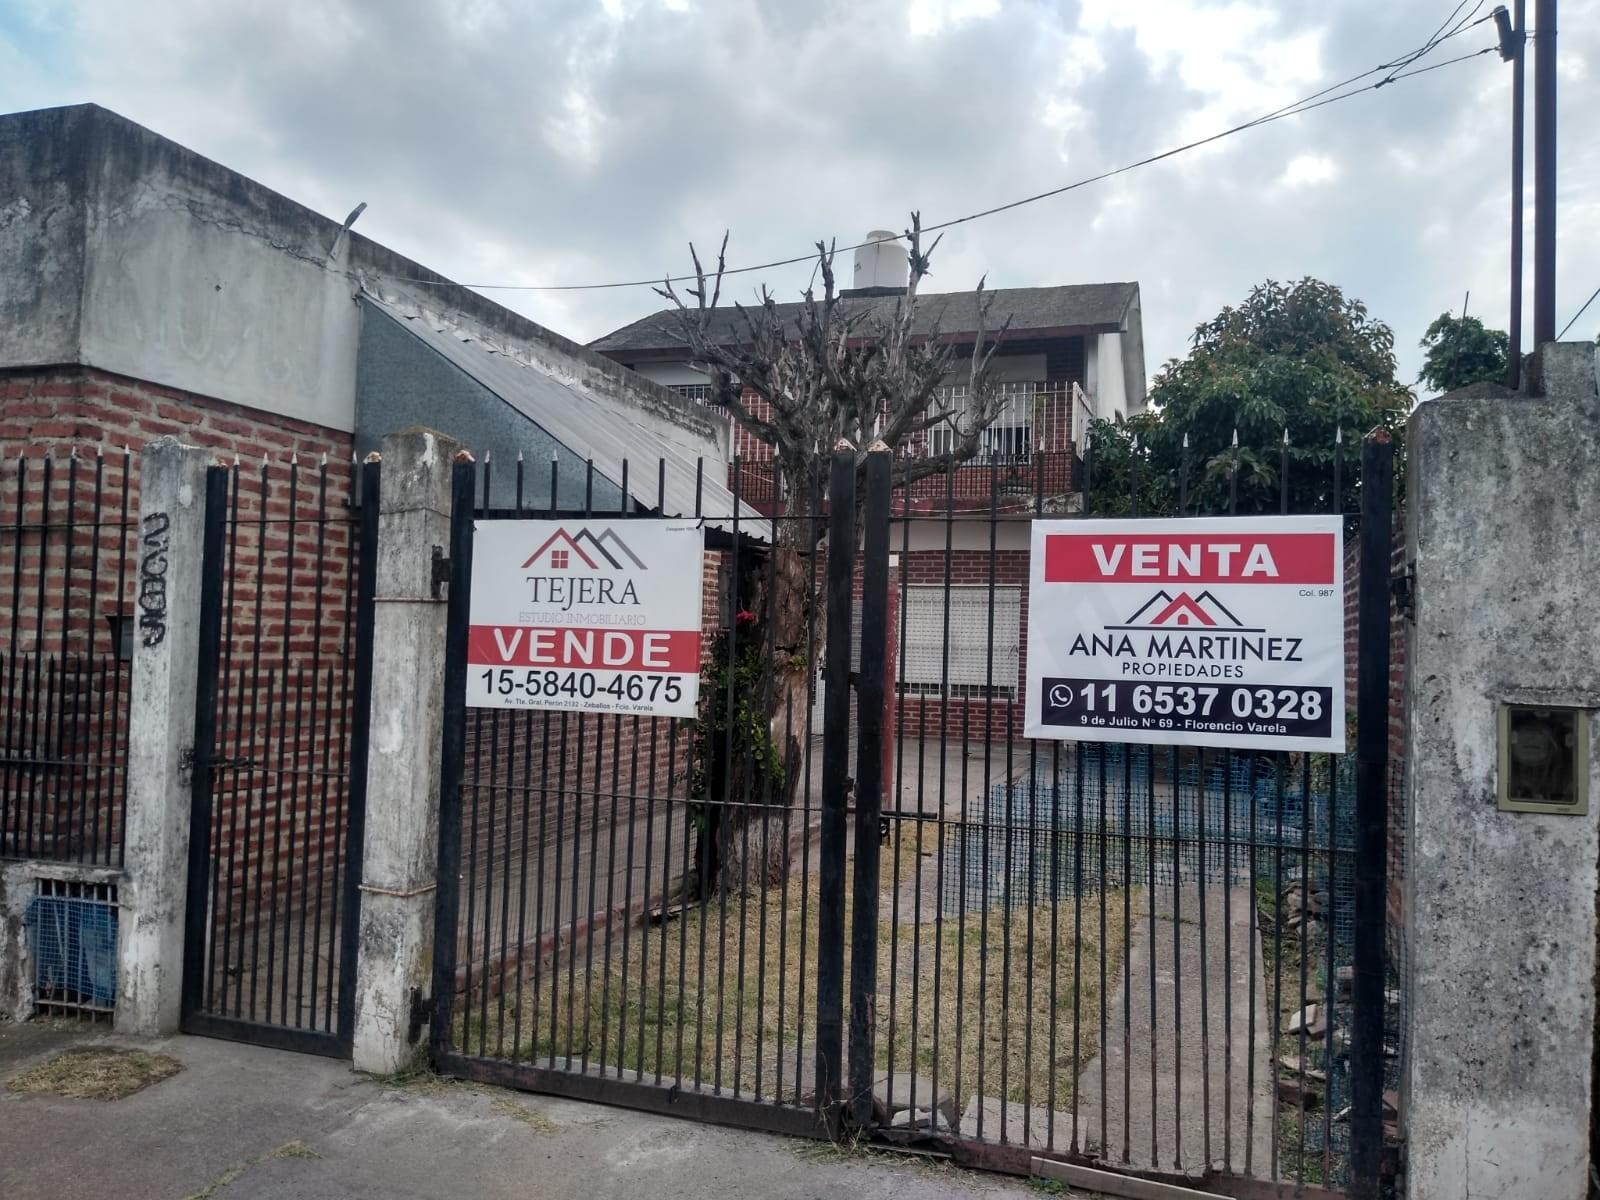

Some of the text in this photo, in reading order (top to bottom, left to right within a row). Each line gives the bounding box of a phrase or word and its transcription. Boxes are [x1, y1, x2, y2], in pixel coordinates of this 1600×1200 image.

[1091, 543, 1279, 577] VENTA
[526, 577, 640, 611] TEJERA
[1299, 589, 1334, 597] Col. 987
[519, 612, 646, 626] ESTUDIO INMOBILIARIO
[494, 628, 671, 667] VENDE
[1069, 633, 1303, 662] ANA MARTINEZ
[482, 669, 682, 702] 15-5840-4675
[1122, 662, 1244, 678] PROPIEDADES
[1080, 683, 1322, 720] 11 6537 0328
[1080, 715, 1088, 725] 9
[1091, 715, 1106, 725] de
[1109, 716, 1138, 727] Julio
[1159, 719, 1173, 728] 69
[1185, 719, 1243, 732] Florencio
[1247, 722, 1287, 733] Varela
